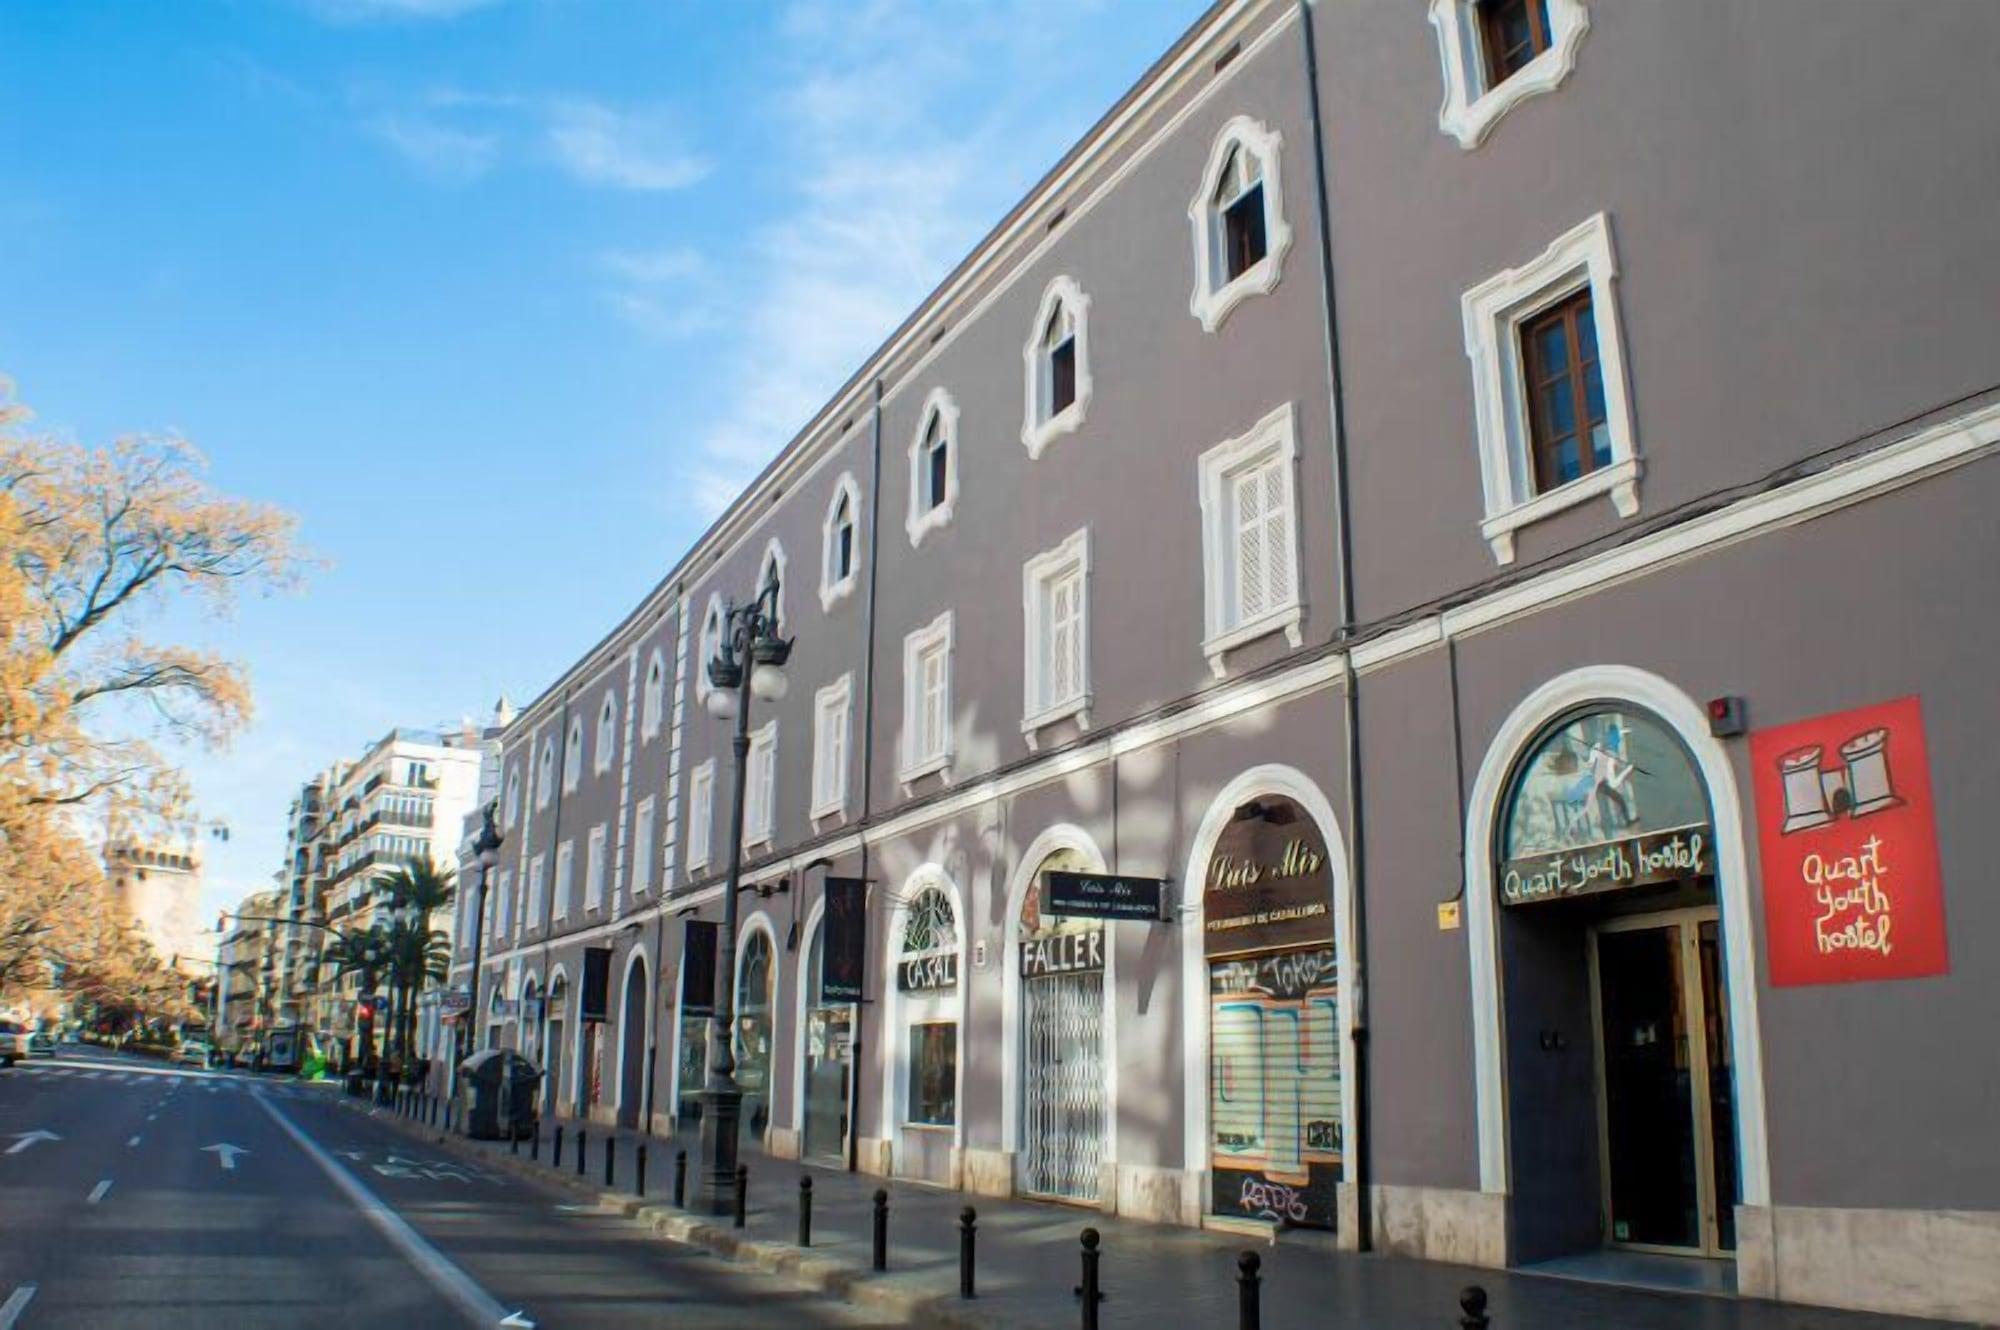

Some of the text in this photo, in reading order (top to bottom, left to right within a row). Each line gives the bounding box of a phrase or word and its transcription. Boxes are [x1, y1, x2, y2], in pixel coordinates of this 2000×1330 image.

[1505, 854, 1567, 899] Quart
[1636, 833, 1704, 874] hostel
[1802, 833, 1888, 884] Quart
[1023, 931, 1103, 976] FALLER
[1816, 914, 1892, 957] hostel
[906, 956, 956, 990] CASAL
